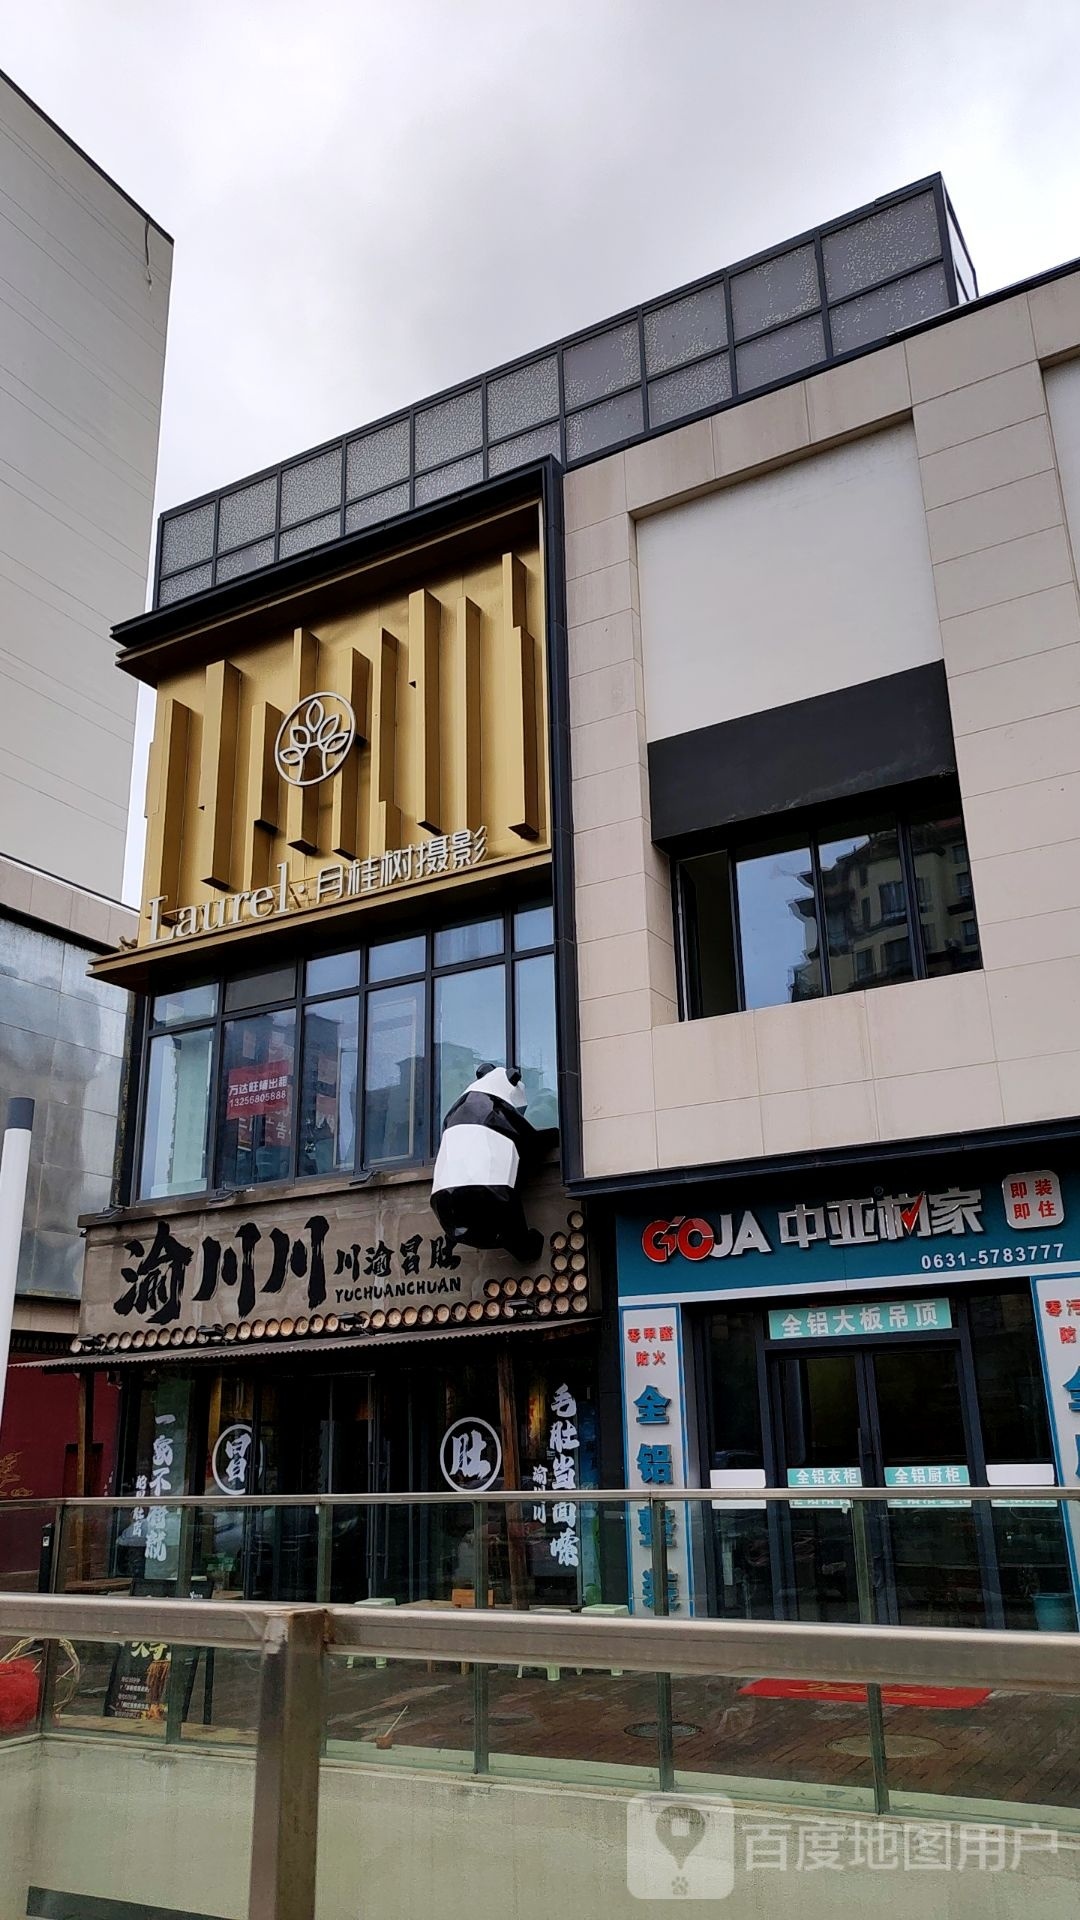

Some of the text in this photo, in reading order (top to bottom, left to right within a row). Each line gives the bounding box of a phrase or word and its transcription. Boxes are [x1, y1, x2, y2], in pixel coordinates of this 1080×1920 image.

[147, 825, 488, 944] Laurel 月桂树摄影
[1010, 1178, 1053, 1199] 即装
[1013, 1200, 1057, 1220] 即住
[921, 1243, 1064, 1270] 0631-5783777
[113, 1215, 330, 1325] 渝川川
[335, 1277, 461, 1303] YUCHUANCHUAN
[781, 1302, 938, 1337] 全铝大板吊顶
[635, 1350, 666, 1367] 防火
[450, 1430, 491, 1479] 肚
[796, 1468, 859, 1486] 全铝衣柜
[894, 1466, 962, 1484] 全铝厨柜
[532, 1464, 548, 1523] 渝川
